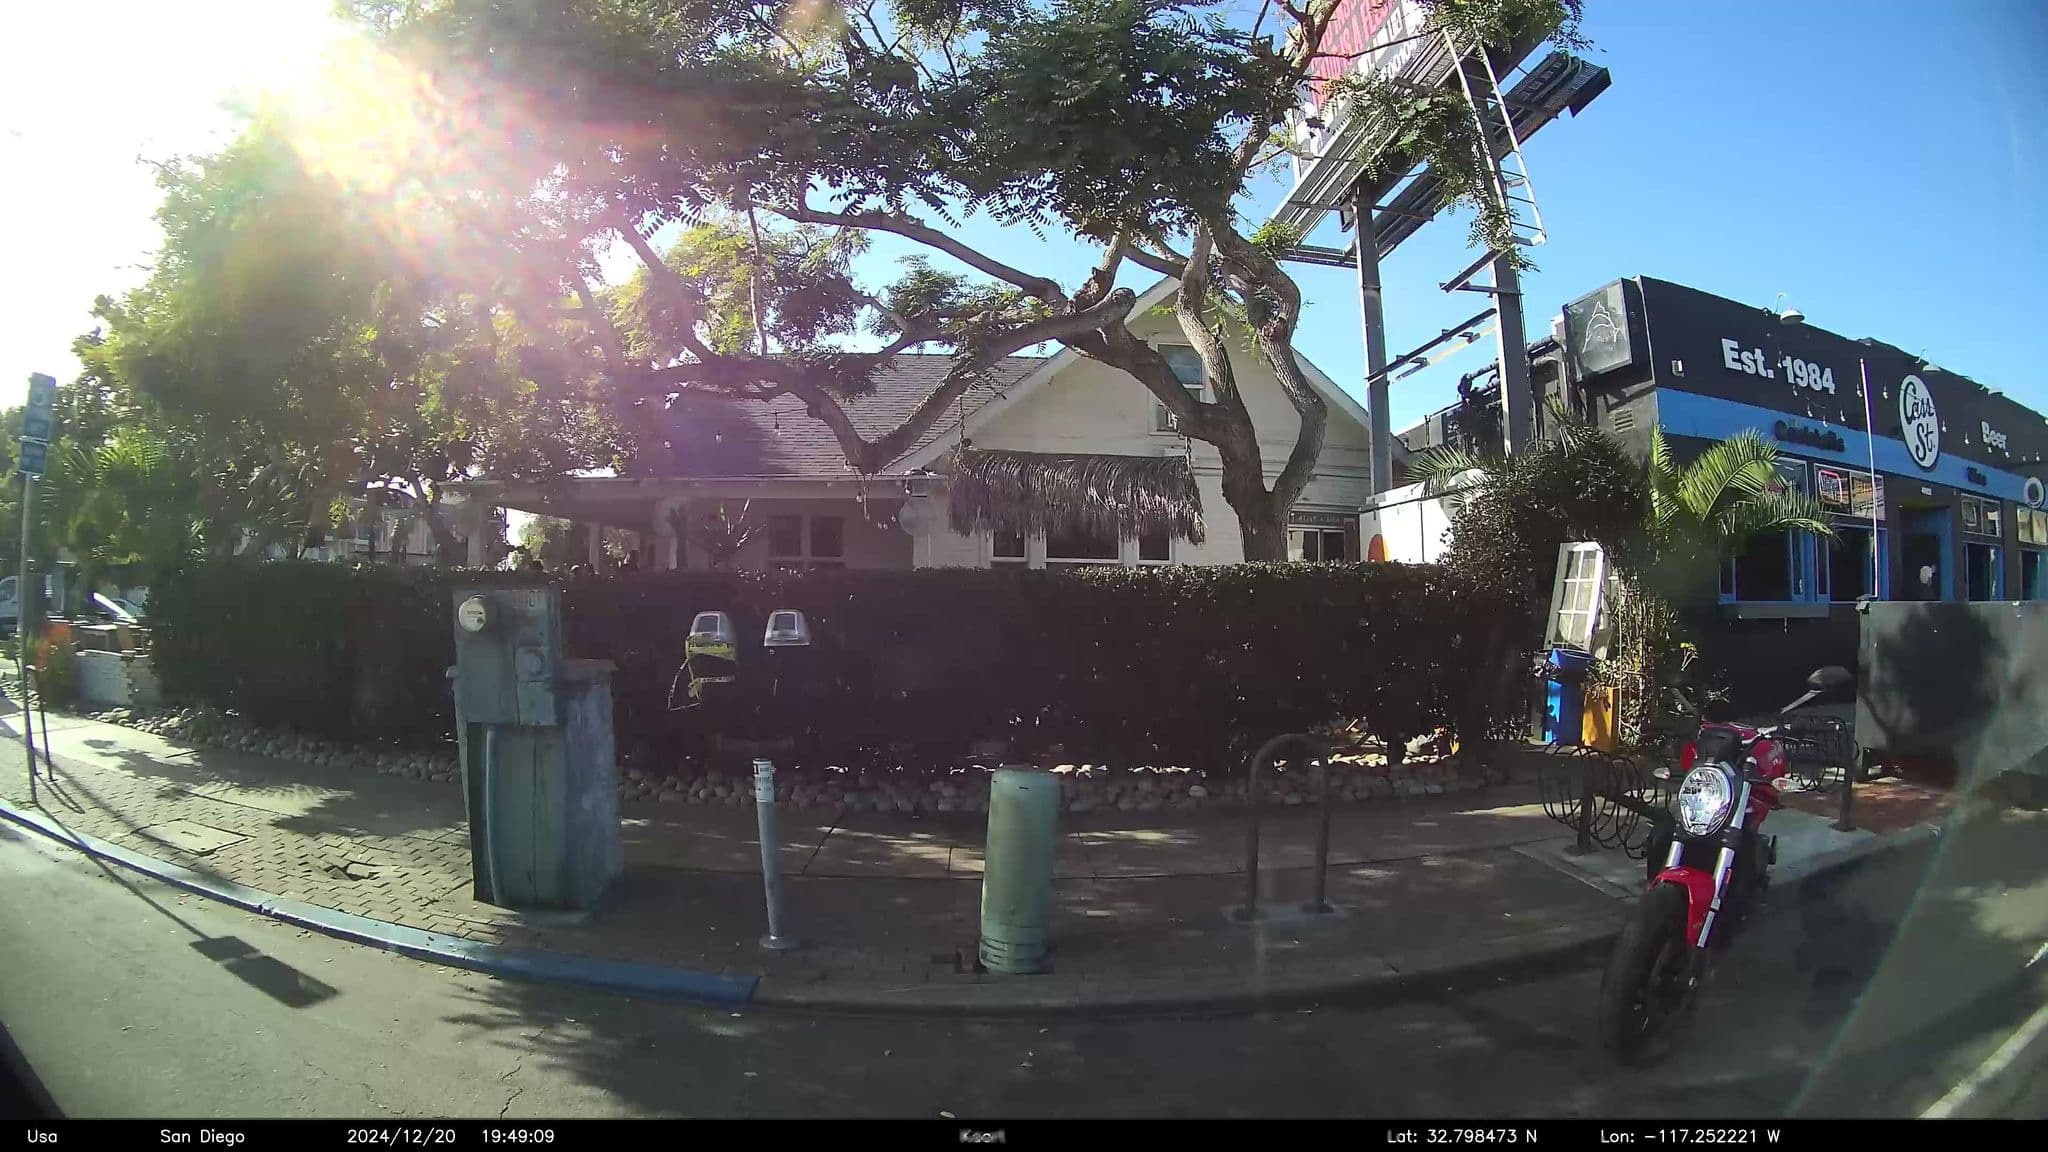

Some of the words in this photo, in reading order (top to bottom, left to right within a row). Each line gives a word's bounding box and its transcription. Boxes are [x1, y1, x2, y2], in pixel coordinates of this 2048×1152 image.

[1721, 338, 1775, 379] Est.
[1782, 355, 1836, 395] 1984
[1903, 381, 1935, 425] Cass
[1916, 422, 1936, 462] St.
[1981, 420, 2007, 450] Beer
